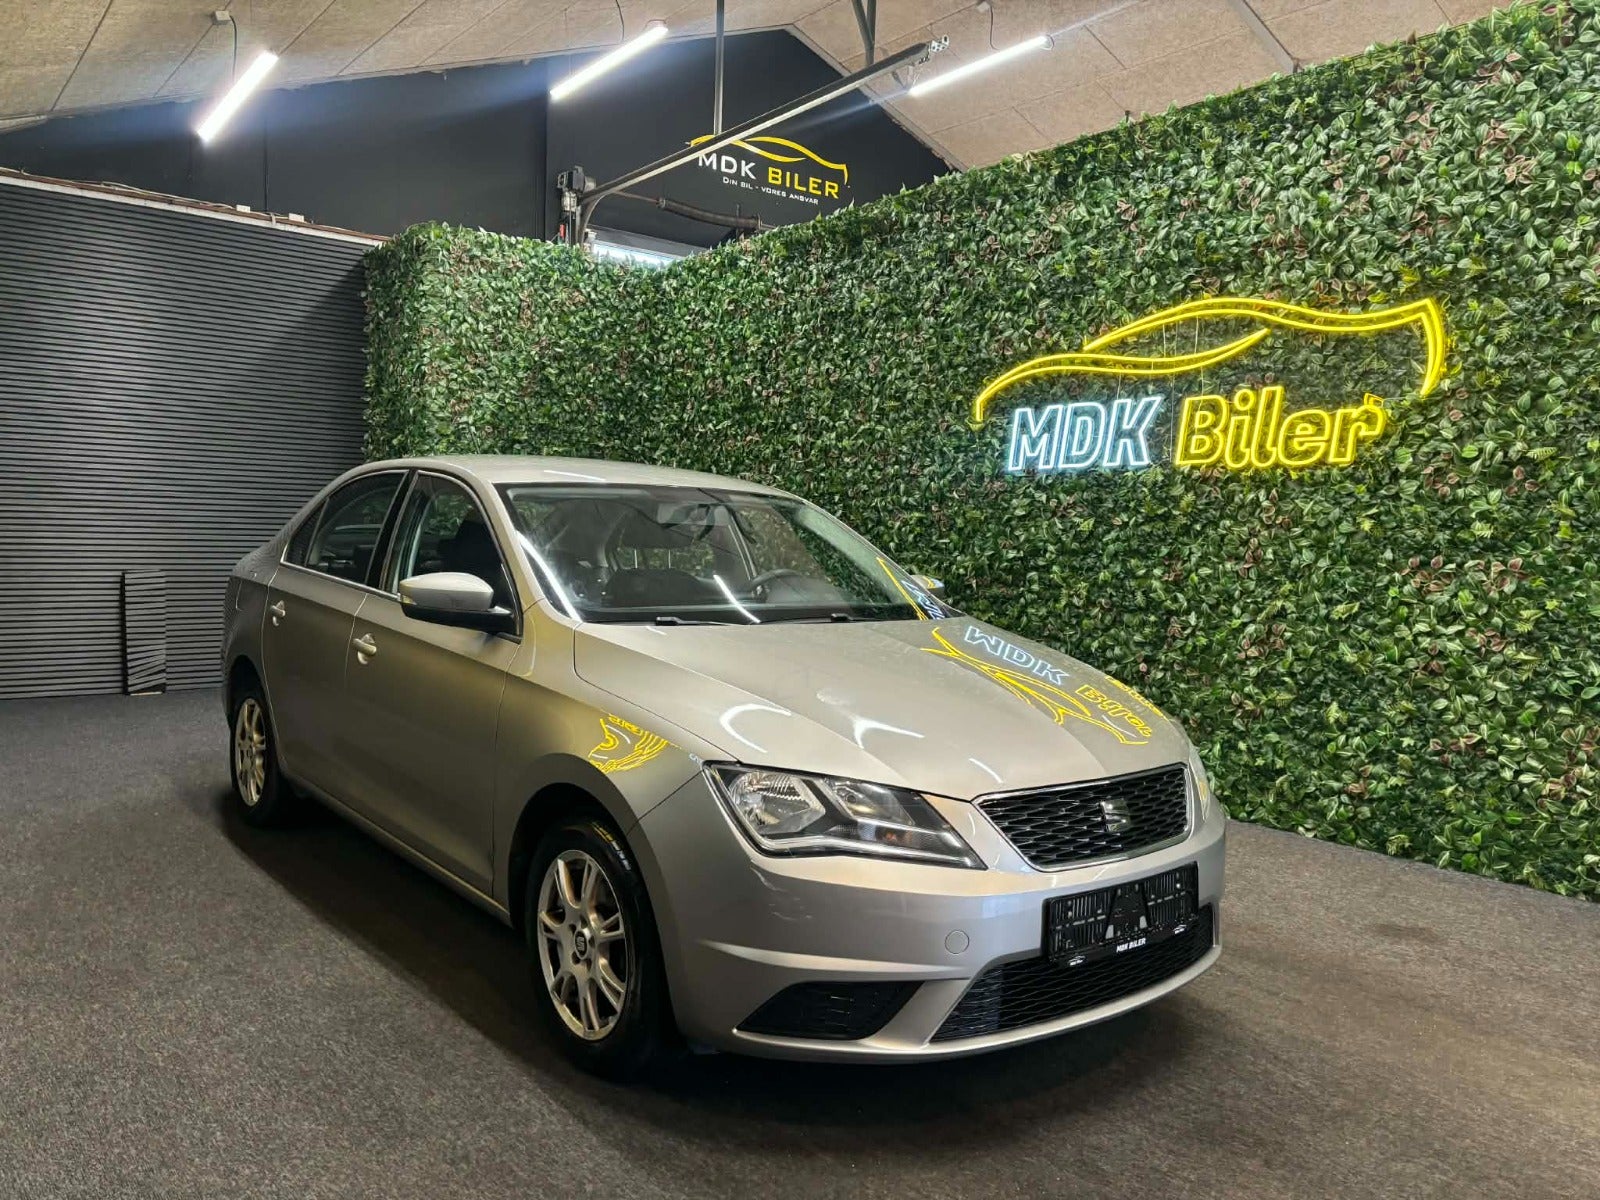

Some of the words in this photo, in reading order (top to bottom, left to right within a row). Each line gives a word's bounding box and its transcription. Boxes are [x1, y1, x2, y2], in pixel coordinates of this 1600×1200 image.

[698, 153, 757, 180] MDK
[768, 166, 839, 199] BILER
[1007, 395, 1165, 471] MDK
[1175, 386, 1386, 469] Biler
